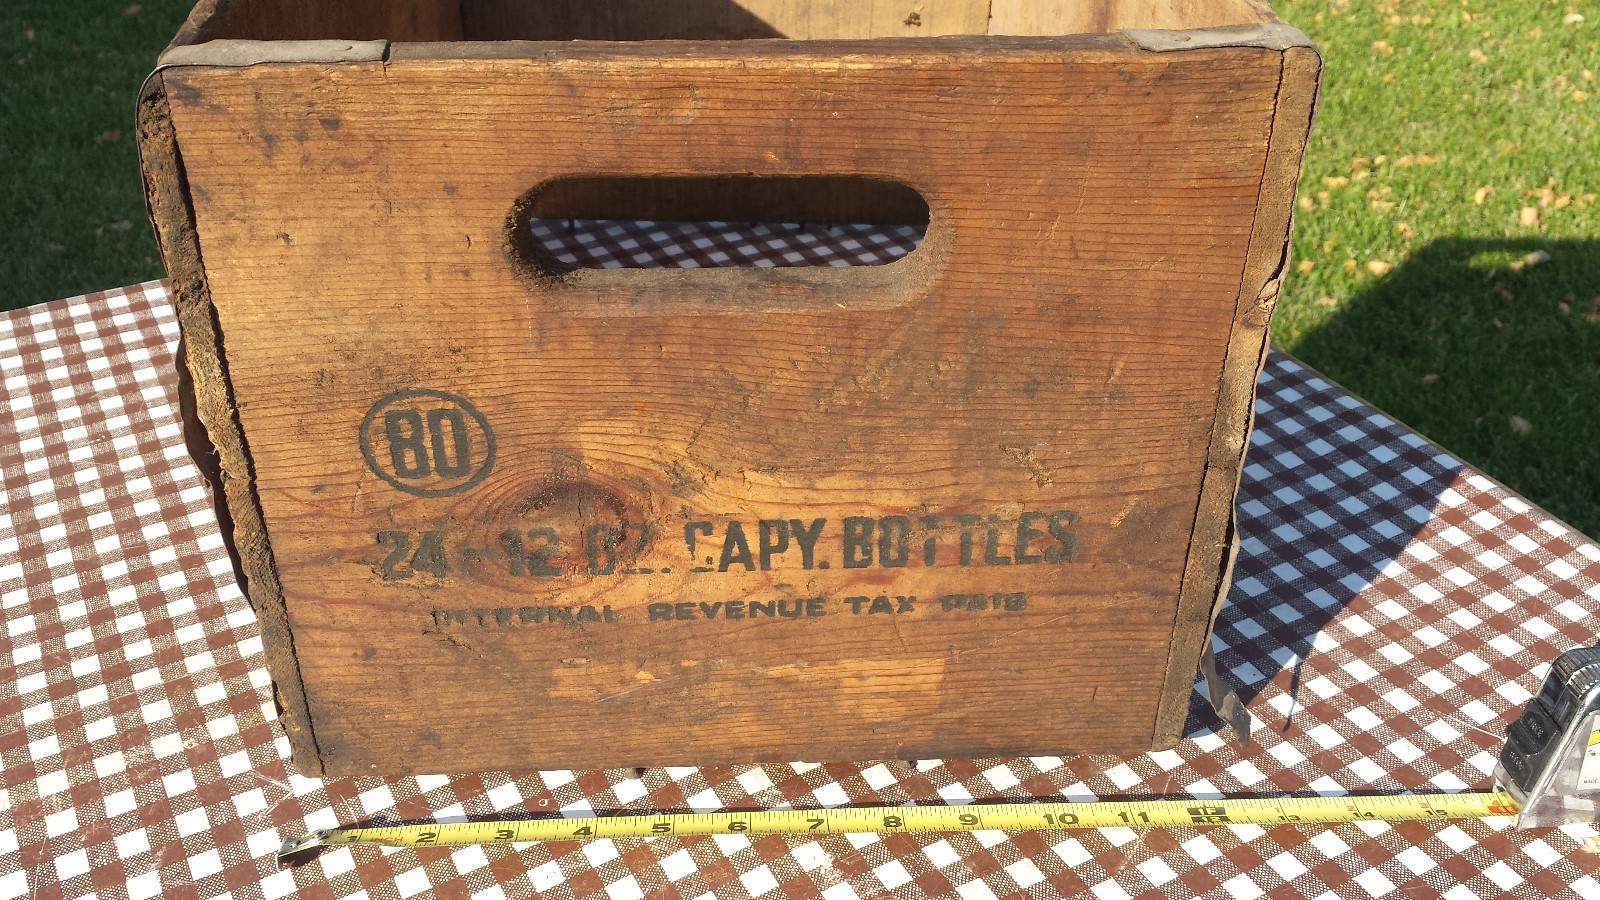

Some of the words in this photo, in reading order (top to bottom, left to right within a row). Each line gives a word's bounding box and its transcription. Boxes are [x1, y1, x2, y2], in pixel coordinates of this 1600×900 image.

[384, 408, 472, 479] 80
[376, 530, 449, 579] 24
[501, 526, 564, 577] 12
[842, 509, 1081, 570] BOTTLES
[648, 597, 827, 622] REVENUE
[844, 595, 917, 616] TAX
[941, 592, 1028, 612] PAID
[415, 832, 437, 843] 2
[493, 829, 515, 840] 3
[571, 825, 594, 837] 4
[651, 822, 672, 834] 5
[727, 820, 749, 832] 6
[805, 818, 825, 830] 7
[882, 815, 903, 828] 8
[958, 813, 979, 826] 9
[1042, 812, 1080, 825] 10
[1116, 811, 1151, 823] 11
